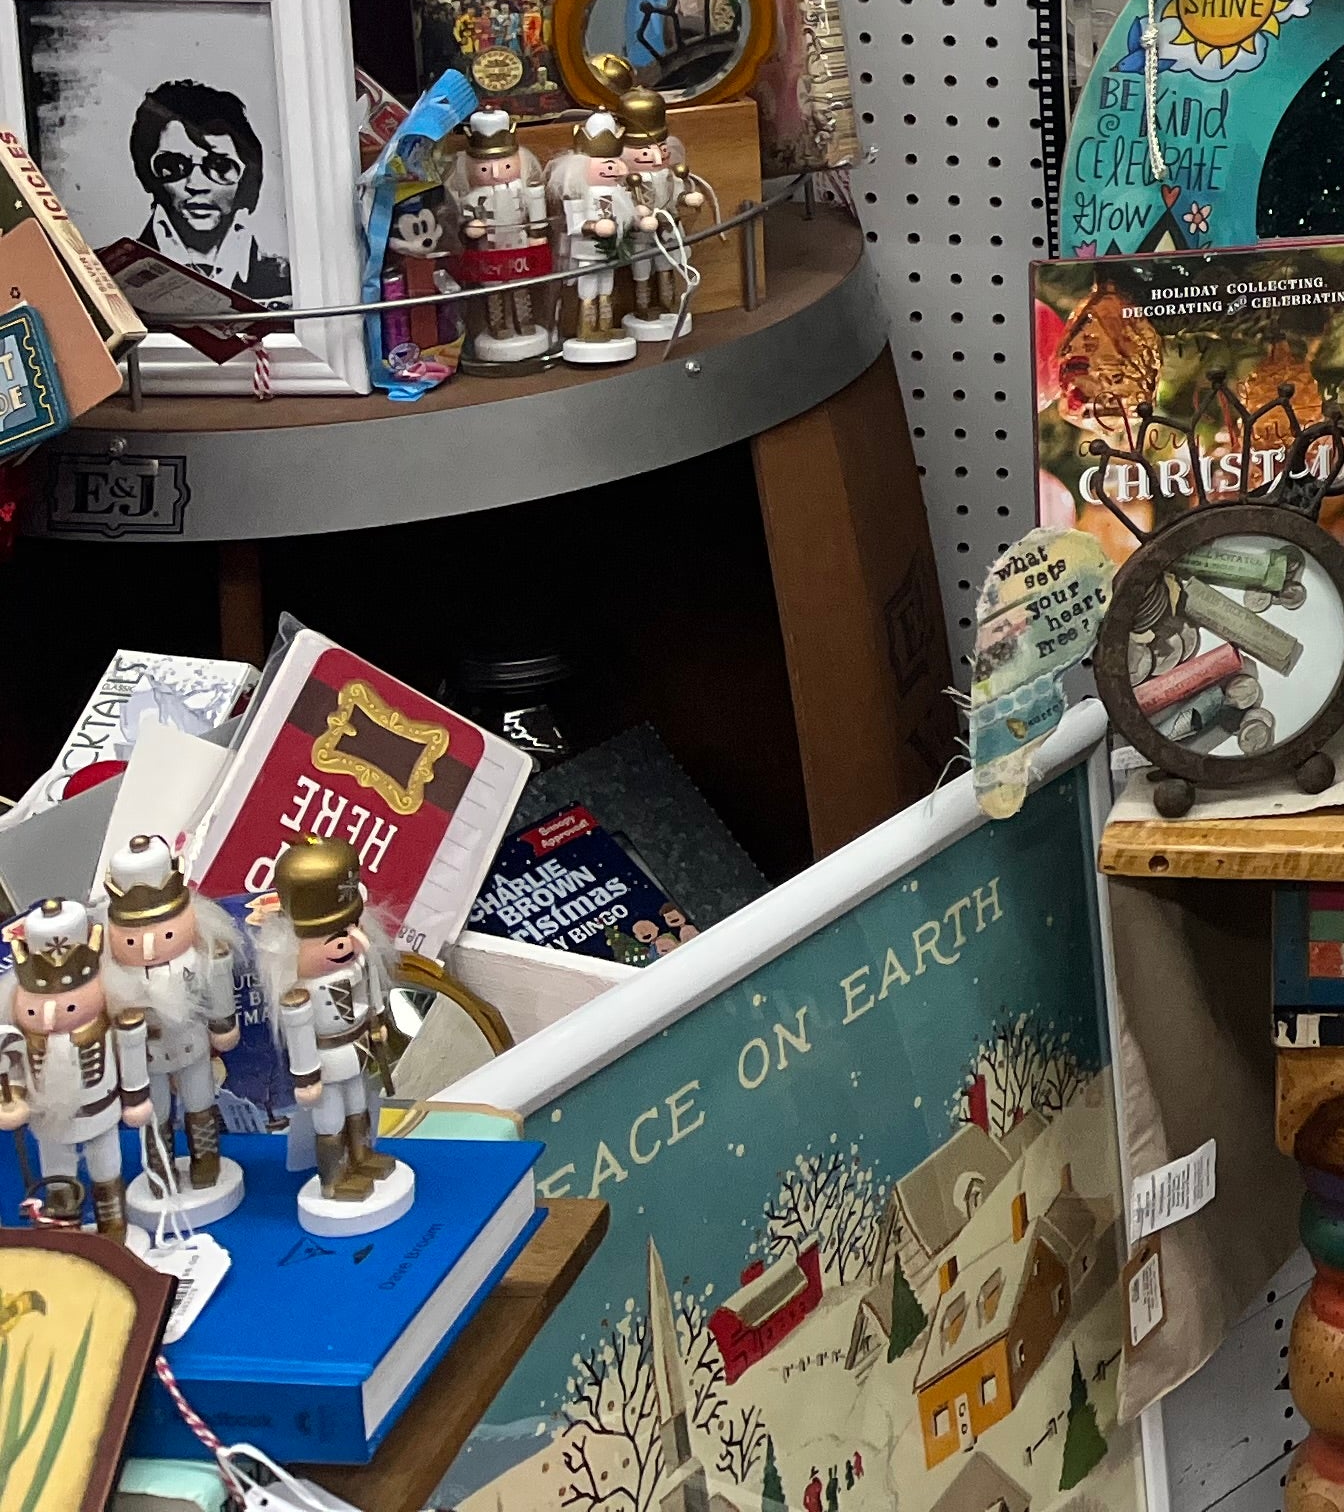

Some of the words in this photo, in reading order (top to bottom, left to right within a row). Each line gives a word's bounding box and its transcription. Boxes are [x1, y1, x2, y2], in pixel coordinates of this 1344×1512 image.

[1100, 76, 1141, 112] BE
[0, 131, 70, 221] ICICLES
[1073, 191, 1153, 235] Grow
[1121, 300, 1223, 320] DECORATING
[1151, 284, 1219, 301] HOLIDAY
[994, 544, 1048, 581] what
[1024, 558, 1066, 589] sets
[1026, 581, 1080, 620] your
[1045, 587, 1106, 632] heart
[280, 775, 399, 873] HERE
[496, 865, 597, 928] BROWN
[567, 904, 629, 944] BINGO
[538, 1080, 708, 1201] EACE
[736, 1006, 812, 1092] ON
[841, 878, 1004, 1026] EARTH
